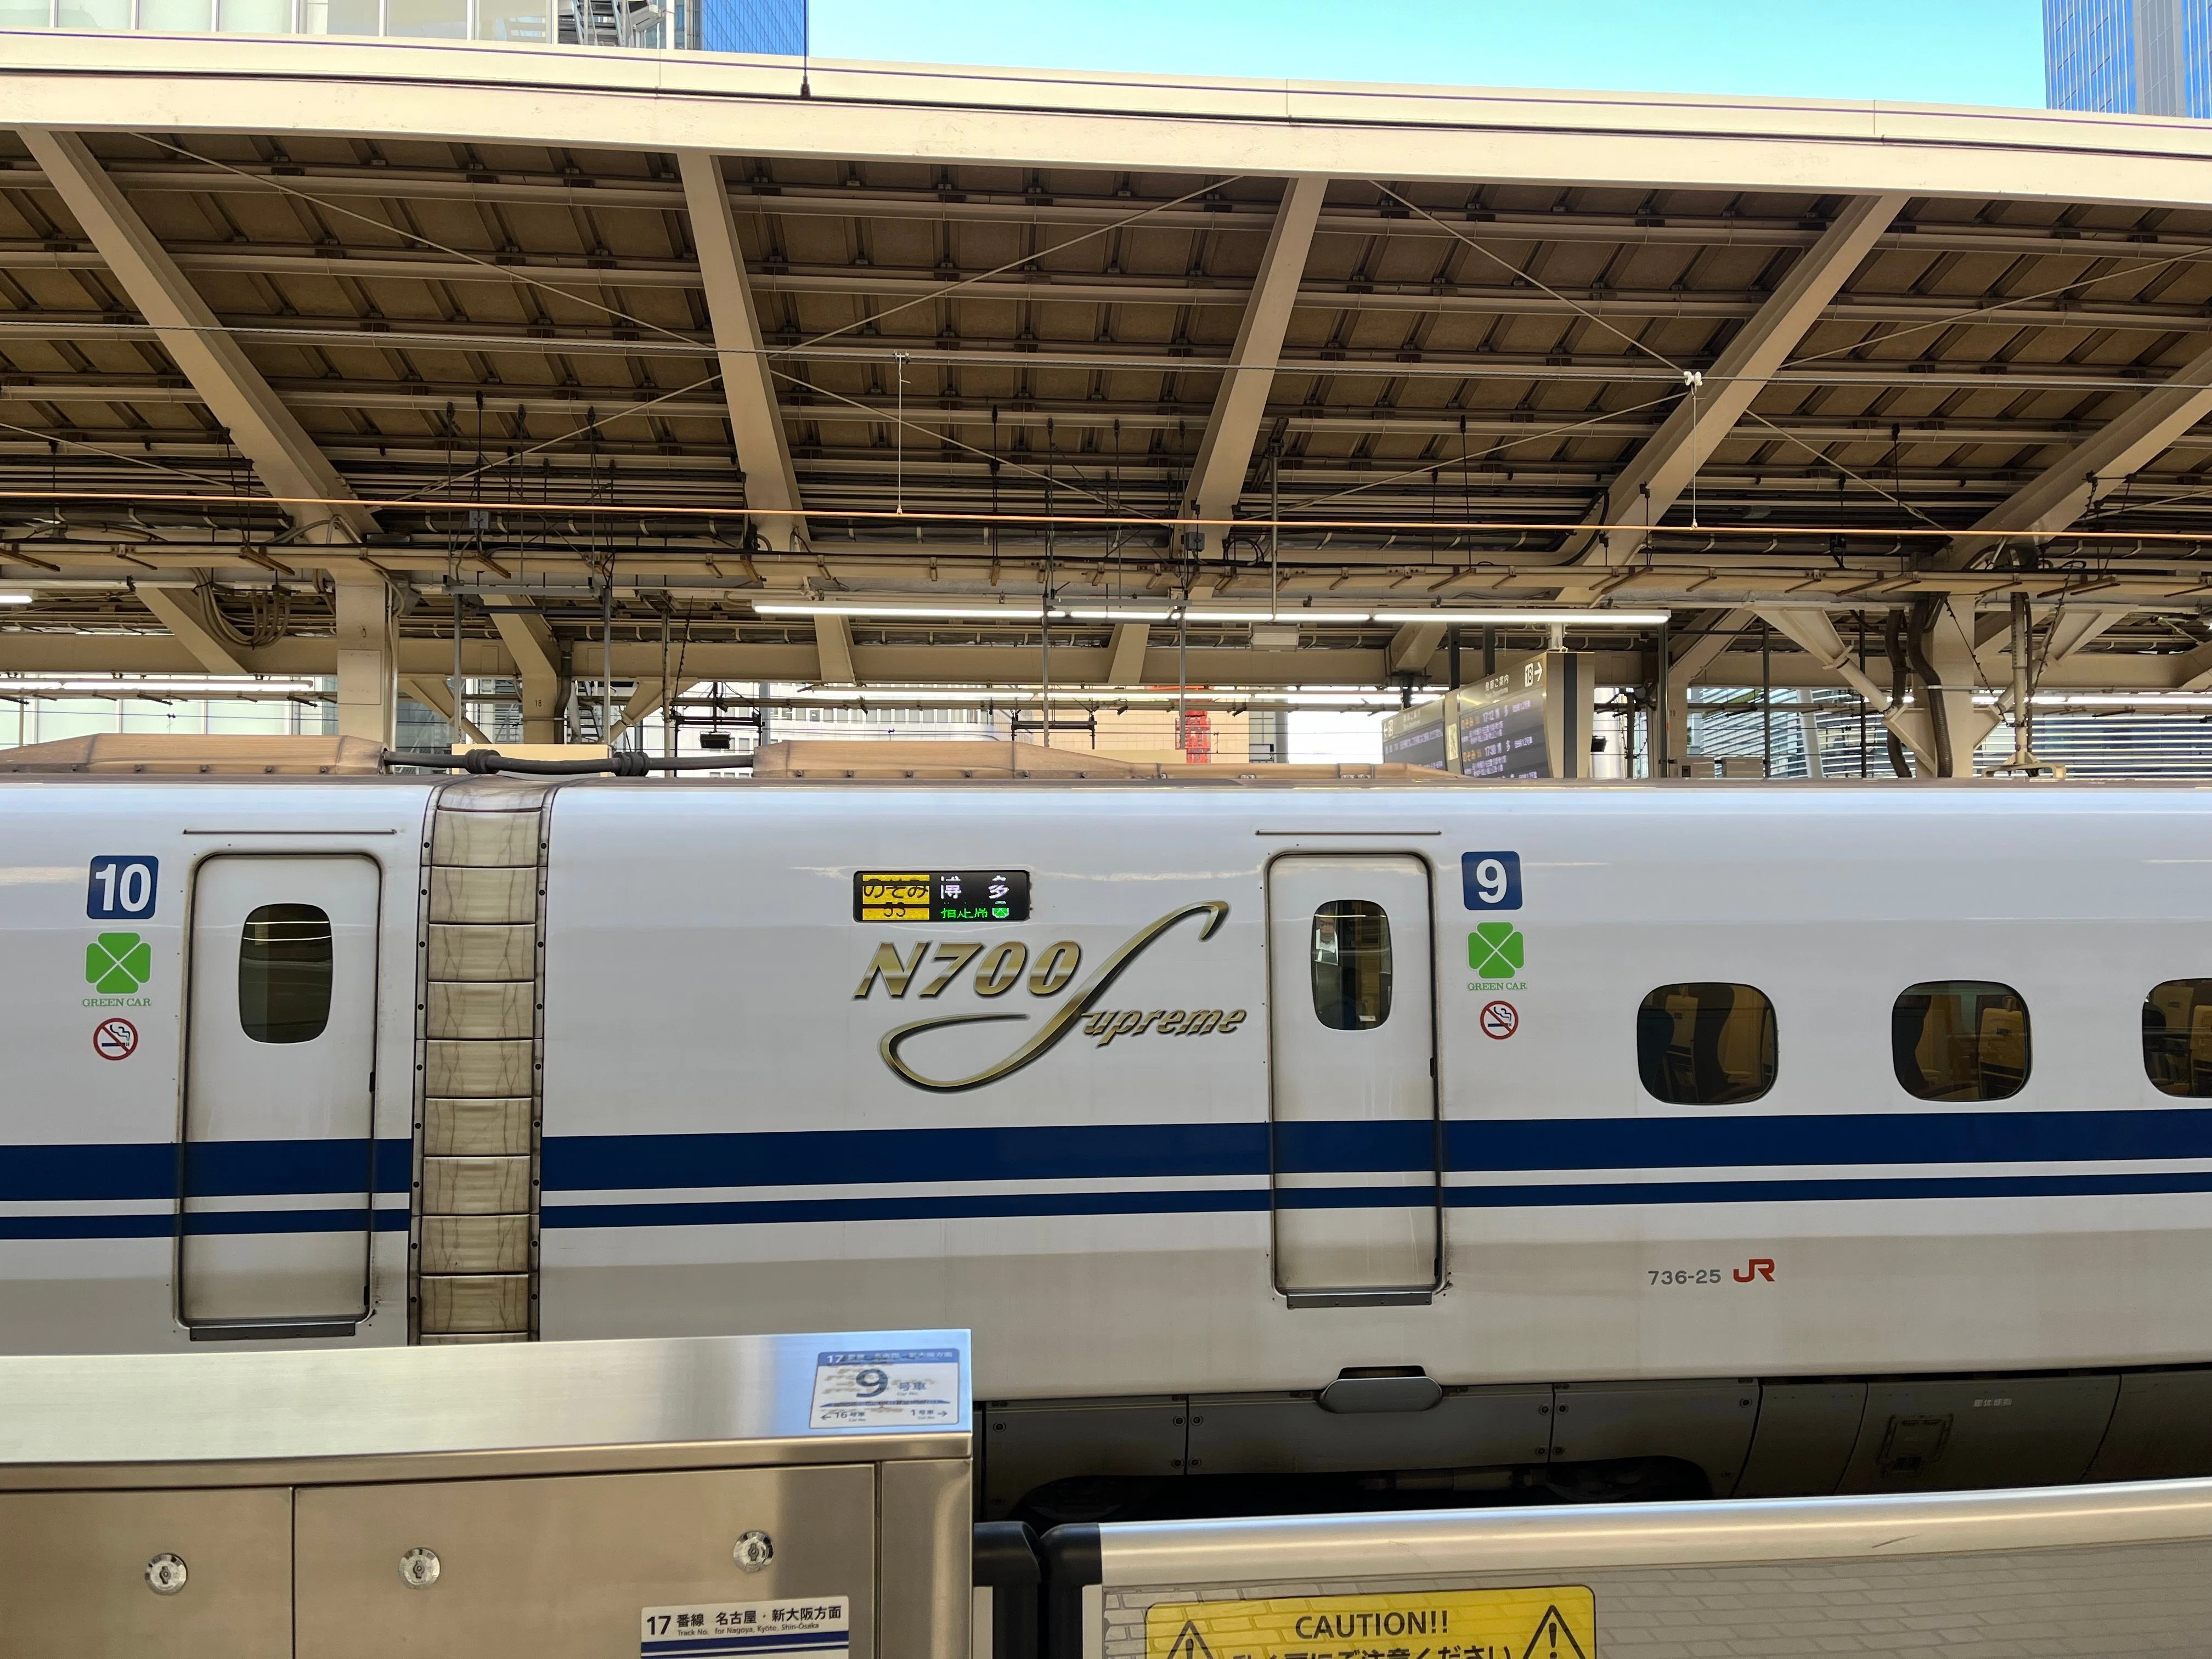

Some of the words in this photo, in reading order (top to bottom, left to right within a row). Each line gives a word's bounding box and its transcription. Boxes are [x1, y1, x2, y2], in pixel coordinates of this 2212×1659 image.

[95, 863, 151, 912] 10
[1476, 859, 1508, 904] 9
[851, 940, 1084, 1001] N700
[1468, 982, 1504, 991] GREEN
[1505, 982, 1527, 990] CAR
[82, 998, 124, 1007] GREEN
[126, 997, 151, 1007] CAR
[1647, 1269, 1722, 1285] 736-25
[1733, 1259, 1776, 1283] JR
[827, 1355, 844, 1364] 17
[855, 1368, 888, 1398] 9
[646, 1615, 672, 1635] 17
[676, 1613, 704, 1628] 番線
[726, 1626, 755, 1635] Nagoya,
[1295, 1610, 1448, 1639] CAUTION!!
